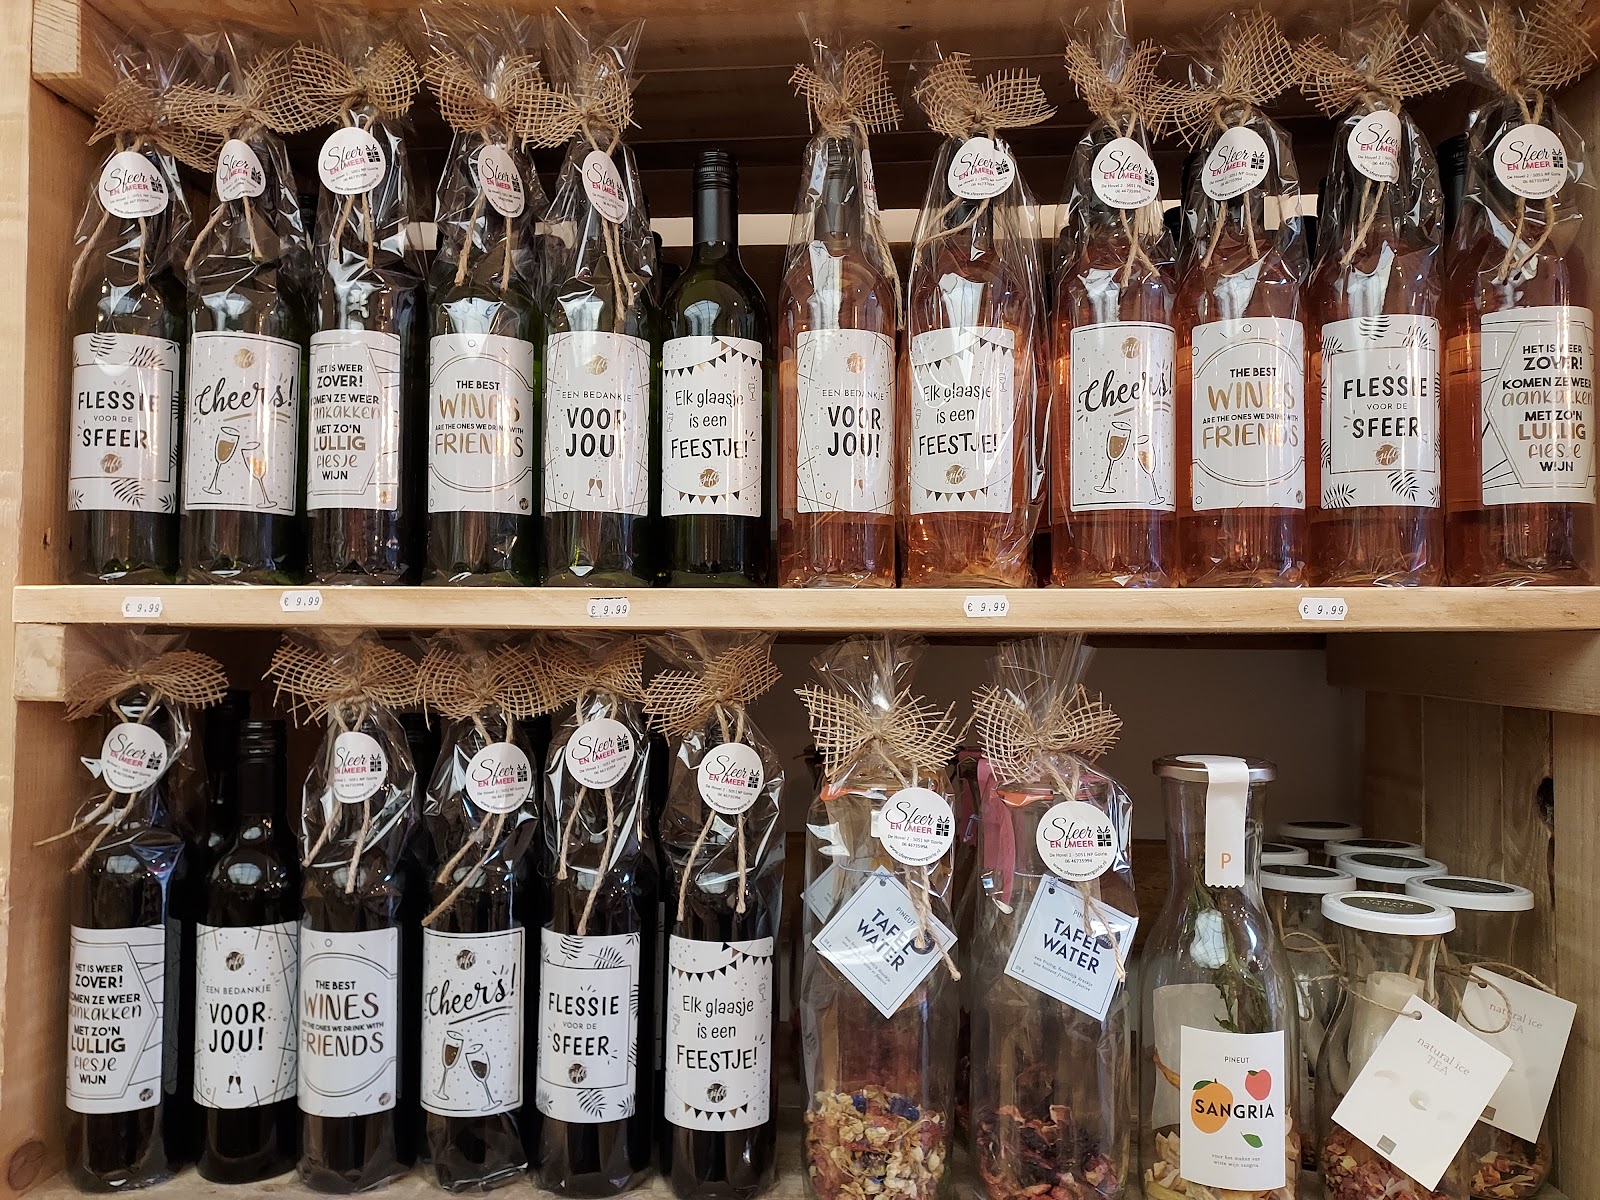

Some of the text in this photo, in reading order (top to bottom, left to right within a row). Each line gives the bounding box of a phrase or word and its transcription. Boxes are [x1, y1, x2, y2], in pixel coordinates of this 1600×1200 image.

[1500, 140, 1550, 170] Sfeer
[1098, 150, 1143, 180] Sfeer
[1526, 161, 1550, 169] MEER
[1121, 172, 1142, 182] MEER
[1522, 344, 1556, 354] HET IS
[316, 364, 328, 374] HET
[337, 364, 364, 373] WEER
[1523, 356, 1583, 370] ZOVER!
[1230, 368, 1277, 378] THE BEST
[316, 375, 363, 389] ZOVER!
[456, 380, 500, 390] THE BEST
[1343, 376, 1428, 400] FLESSIE
[1502, 376, 1592, 390] KOMEN ZE WEER
[194, 375, 294, 416] Cheers!
[334, 394, 380, 404] ZE WEER
[675, 389, 744, 408] Elk glaasje
[923, 386, 940, 401] Elk
[121, 415, 133, 423] DE
[566, 406, 627, 430] VOOR
[690, 414, 727, 428] is een
[828, 405, 882, 430] VOOR
[936, 408, 976, 424] is een
[1231, 413, 1252, 421] ONES
[1525, 410, 1582, 422] MET ZO'N
[316, 424, 361, 434] MET ZO'N
[1352, 416, 1419, 438] SFEER
[82, 428, 148, 450] SFEER
[314, 436, 366, 452] LULLIG
[827, 432, 880, 458] JOU!
[919, 432, 998, 456] FEESTJE!
[671, 438, 748, 458] FEESTJE!
[1540, 462, 1574, 472] WIJN
[322, 471, 348, 480] WIJN
[126, 603, 160, 612] € 9.99
[284, 596, 320, 606] € 9.99
[591, 604, 628, 614] € 9.99
[968, 602, 1006, 612] € 9.99
[1303, 604, 1344, 615] € 9.99
[472, 758, 514, 786] Sfeer
[706, 755, 747, 784] Sfeer
[478, 776, 515, 787] EN MEER
[708, 774, 746, 787] EN MEER
[886, 801, 936, 832] Sfeer
[890, 822, 933, 835] EN MEER
[1043, 817, 1094, 848] Sfeer
[1220, 852, 1232, 870] P
[896, 907, 916, 926] PINEUT
[871, 908, 914, 956] TAFEL
[1054, 918, 1101, 954] TAFEL
[856, 918, 906, 972] WATER
[1043, 933, 1100, 974] WATER
[87, 964, 94, 973] IS
[96, 964, 124, 973] WEER
[75, 974, 123, 988] ZOVER!
[316, 980, 356, 990] THE BEST
[426, 962, 517, 1016] Cheers!
[206, 984, 272, 995] EEN BEDANKJE
[92, 994, 140, 1004] ZE WEER
[304, 990, 380, 1022] WINES
[548, 992, 620, 1017] FLESSIE
[682, 995, 754, 1018] Elk glaasje
[209, 1002, 266, 1025] VOOR
[1489, 1003, 1543, 1030] natral ice
[74, 1024, 120, 1036] MET ZO'N
[344, 1024, 365, 1032] DRINK
[366, 1021, 384, 1031] WITH
[562, 1021, 598, 1030] VOOR DE
[697, 1022, 736, 1040] is een
[71, 1036, 126, 1054] LULLIG
[209, 1027, 264, 1054] JOU!
[302, 1030, 384, 1058] FRIENDS
[552, 1032, 610, 1056] SFEER
[676, 1044, 758, 1072] FEESTJE!
[1224, 1056, 1250, 1064] PINEUT
[1418, 1037, 1470, 1076] natural ice
[1426, 1055, 1448, 1076] TEA
[79, 1074, 106, 1085] WIJN
[1194, 1098, 1276, 1120] SANGRIA
